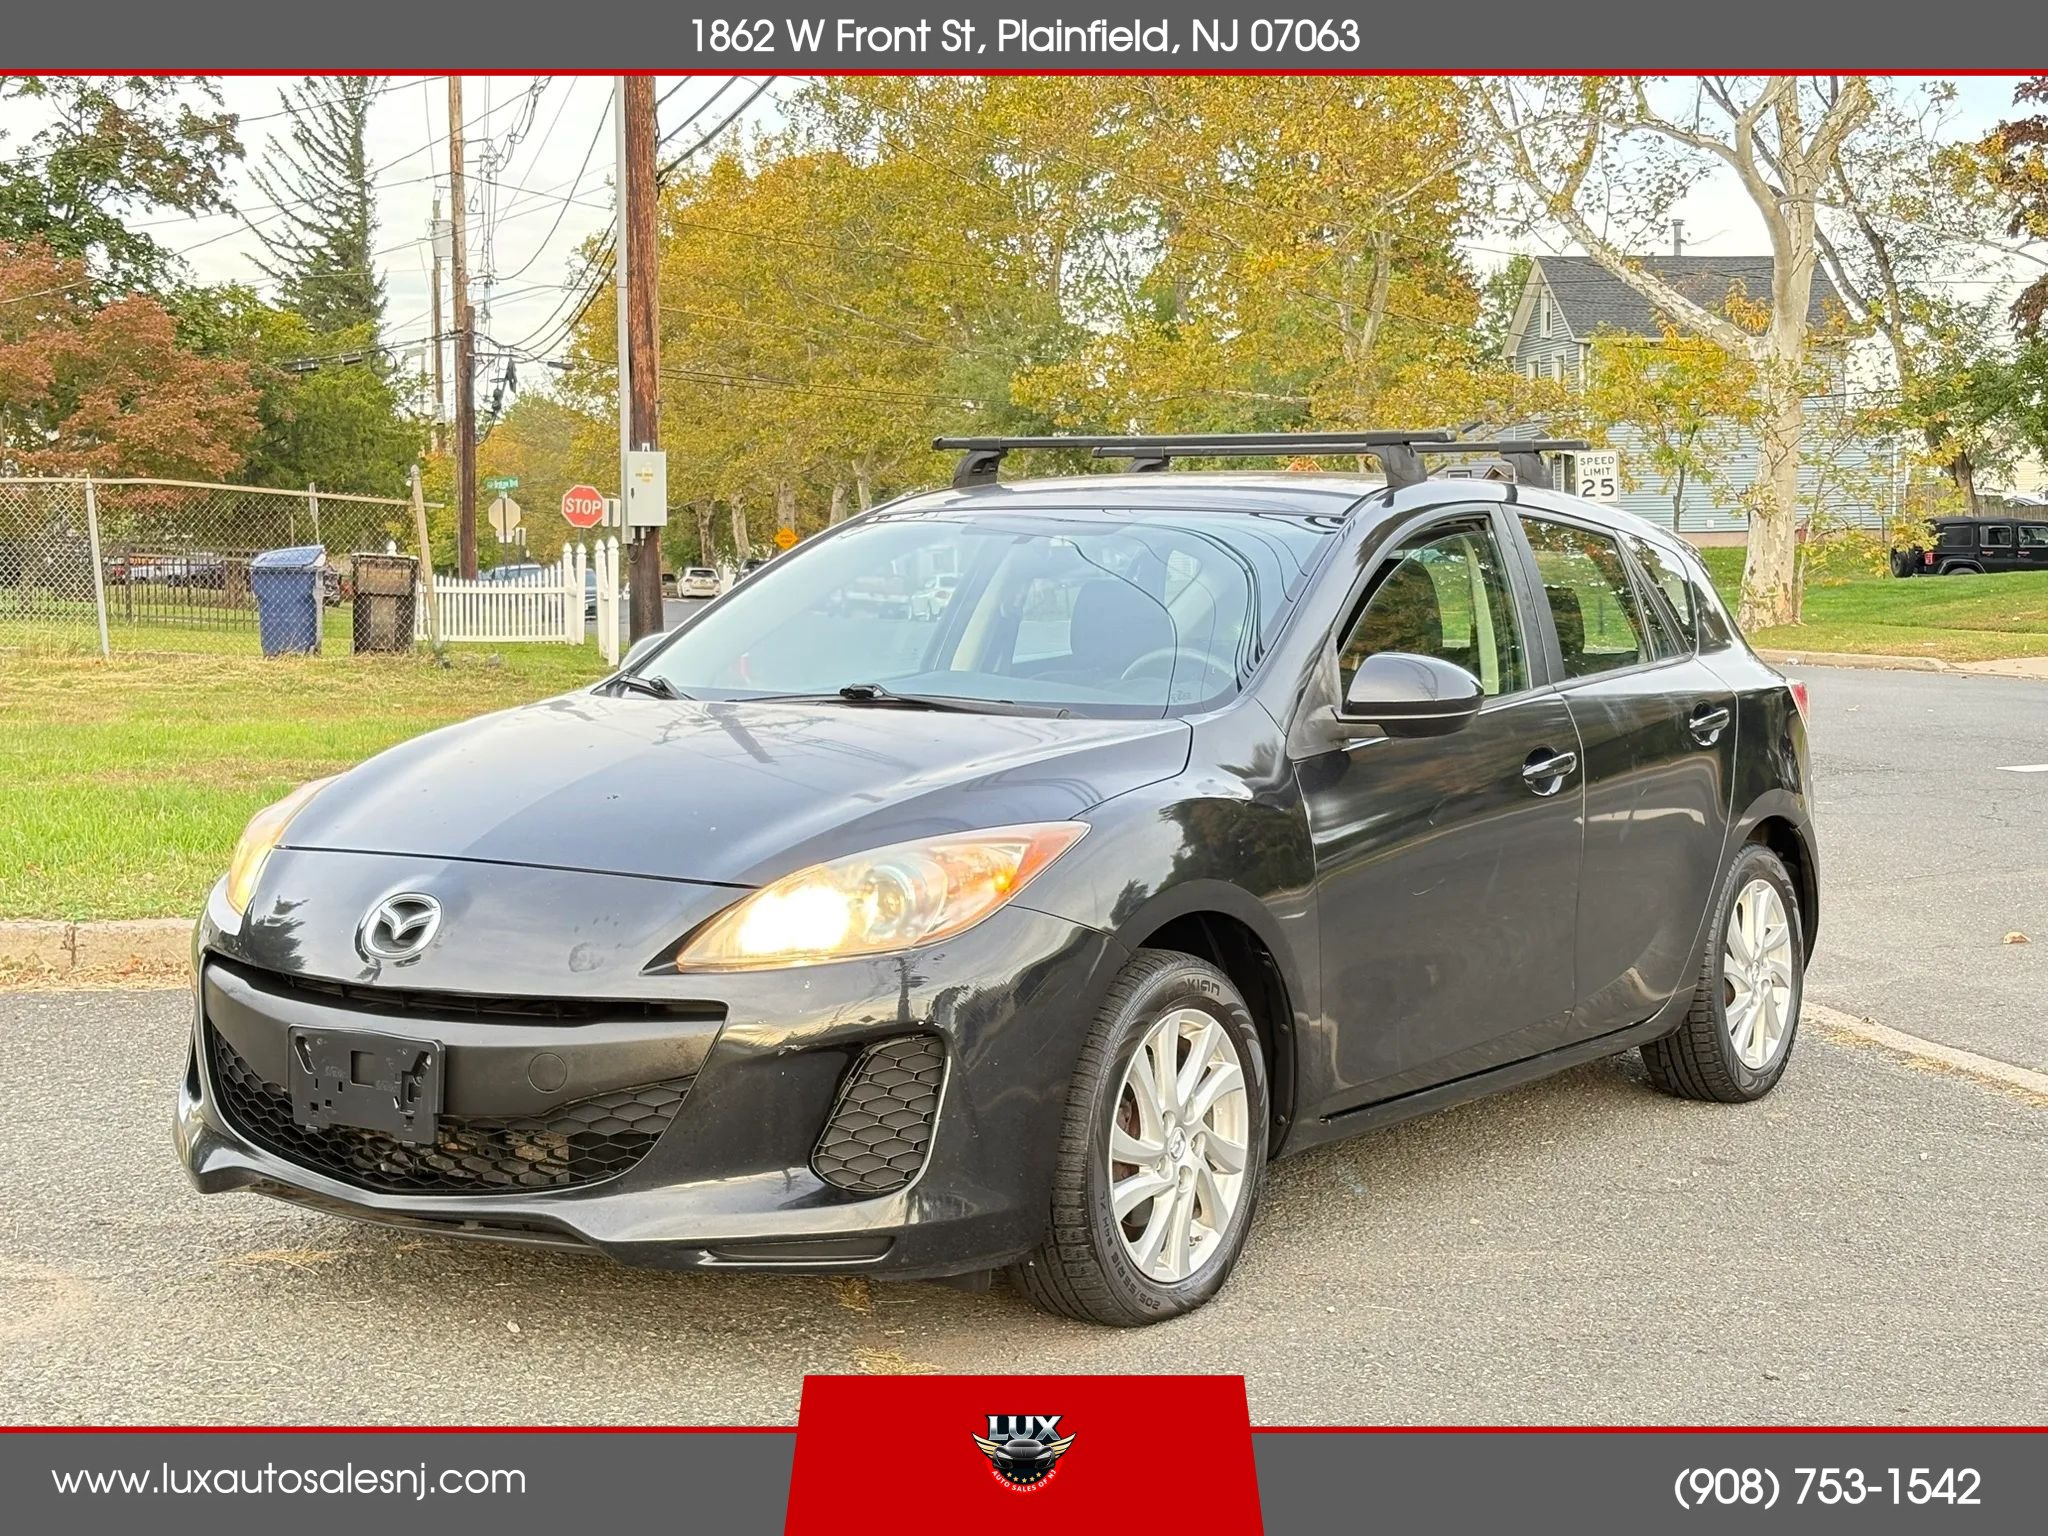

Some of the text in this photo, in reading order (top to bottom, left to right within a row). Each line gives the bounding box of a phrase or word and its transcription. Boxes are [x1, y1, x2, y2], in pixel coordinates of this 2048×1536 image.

[1580, 456, 1615, 466] SPEED
[1583, 467, 1611, 476] LIMIT
[1581, 478, 1615, 498] 25
[565, 497, 602, 516] STOP
